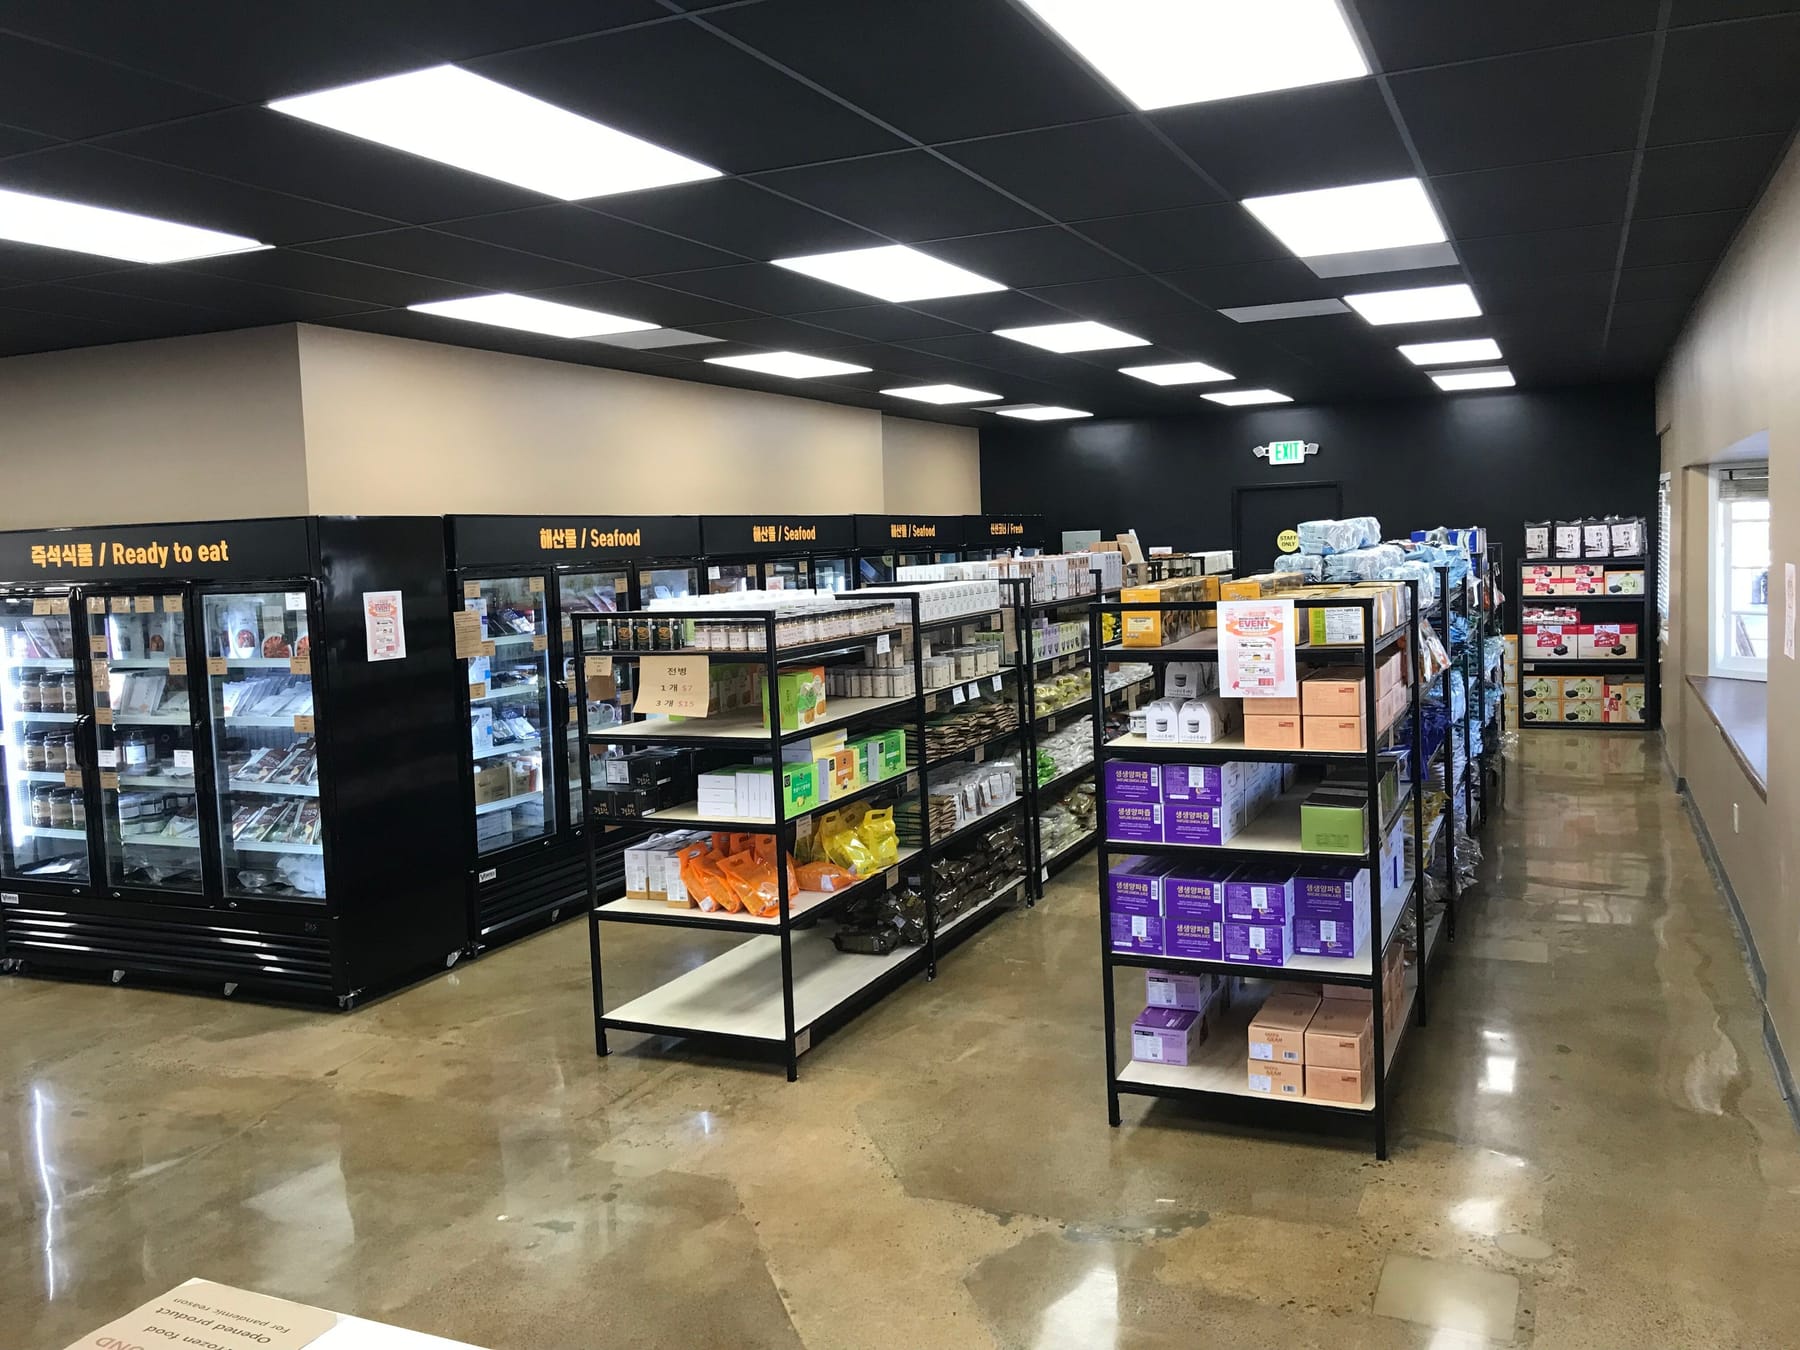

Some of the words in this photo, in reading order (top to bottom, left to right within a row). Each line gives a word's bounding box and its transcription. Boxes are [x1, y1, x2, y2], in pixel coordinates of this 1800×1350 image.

[1275, 443, 1299, 461] EXIT
[753, 525, 776, 542] 해산물
[784, 525, 816, 541] Seafood
[912, 524, 936, 538] Seafood
[1010, 522, 1024, 535] Fresh
[540, 528, 577, 549] 해산물
[581, 528, 587, 549] /
[590, 528, 640, 548] Seafood
[31, 543, 93, 568] 즉석식품
[99, 542, 107, 567] /
[112, 541, 169, 569] Ready
[173, 541, 193, 563] to
[198, 540, 229, 562] eat
[1238, 620, 1270, 628] EVENT
[667, 667, 687, 676] 전병
[173, 1298, 211, 1311] reason
[155, 1307, 215, 1326] product
[212, 1309, 270, 1326] pandemic
[142, 1325, 180, 1340] food
[211, 1323, 271, 1344] Opened
[270, 1324, 291, 1334] For
[183, 1336, 232, 1350] rozen
